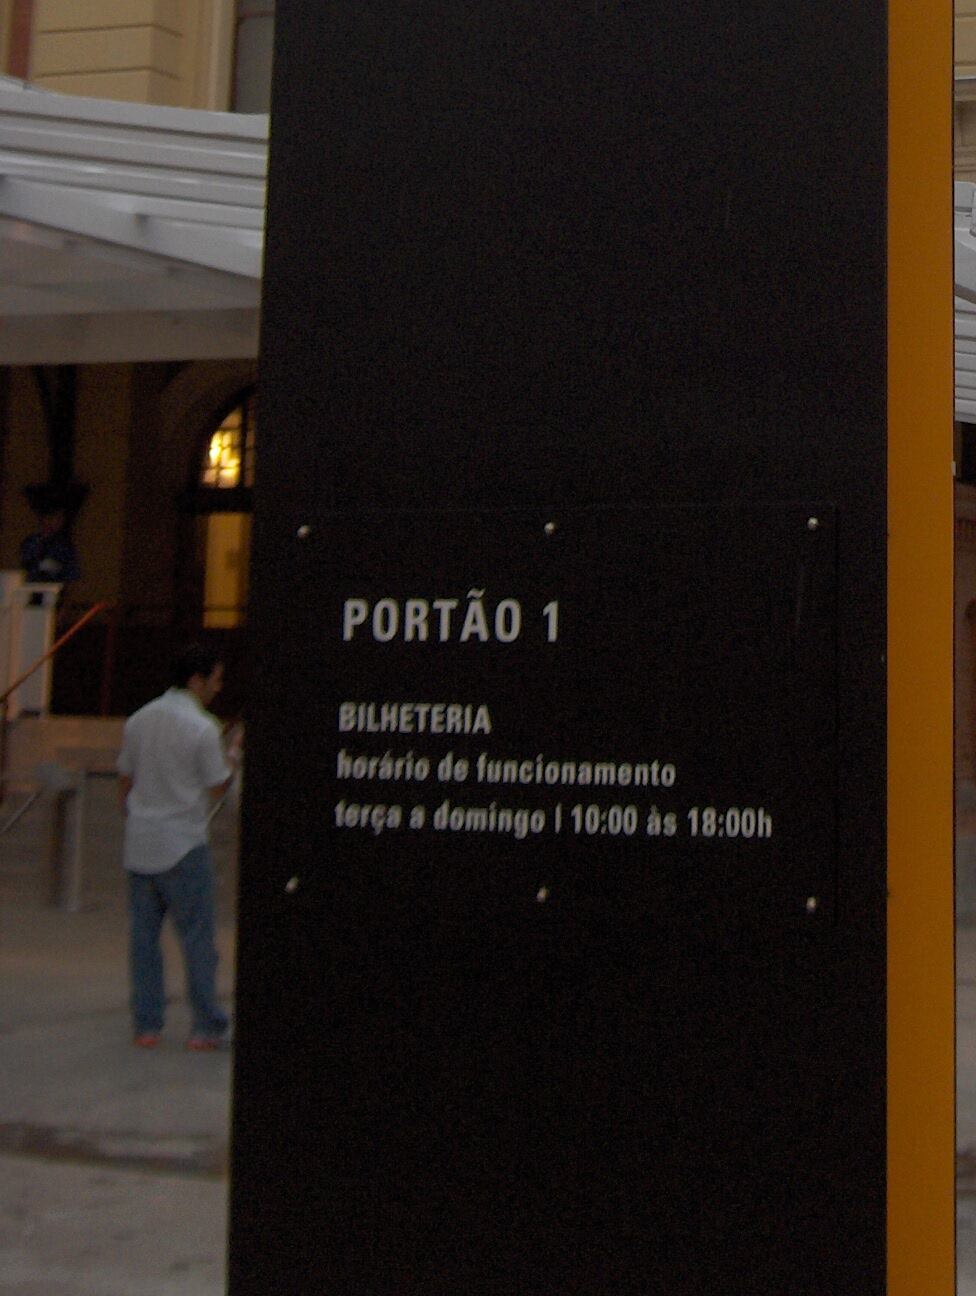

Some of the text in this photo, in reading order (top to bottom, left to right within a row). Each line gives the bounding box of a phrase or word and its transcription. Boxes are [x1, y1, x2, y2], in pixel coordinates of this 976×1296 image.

[343, 589, 559, 643] PORTÃO 1
[338, 702, 492, 734] BILHETERIA
[336, 749, 676, 787] horário de funcionamento
[334, 800, 402, 835] terça
[409, 806, 426, 829] a
[433, 800, 546, 839] domingo
[571, 804, 638, 835] 10:00
[687, 807, 773, 838] 18:00h
